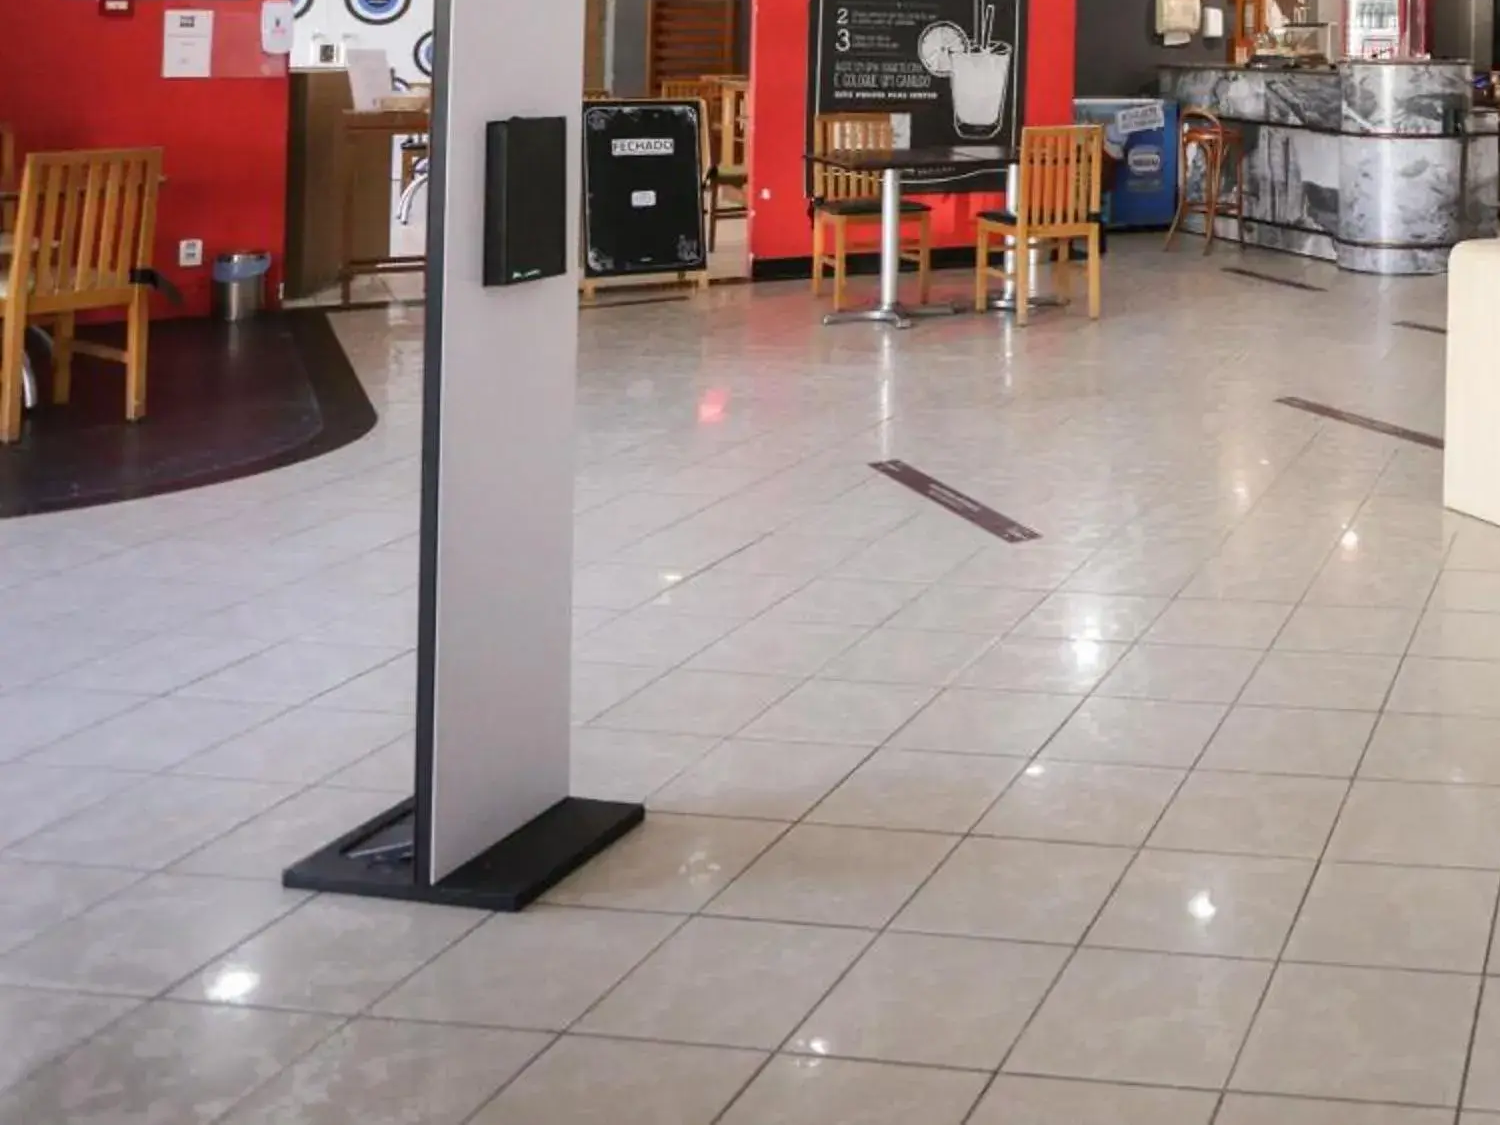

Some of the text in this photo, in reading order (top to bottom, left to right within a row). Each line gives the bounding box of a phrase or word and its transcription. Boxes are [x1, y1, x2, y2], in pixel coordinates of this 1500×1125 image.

[836, 7, 849, 25] 2
[835, 27, 850, 52] 3
[612, 139, 673, 153] FECHADO
